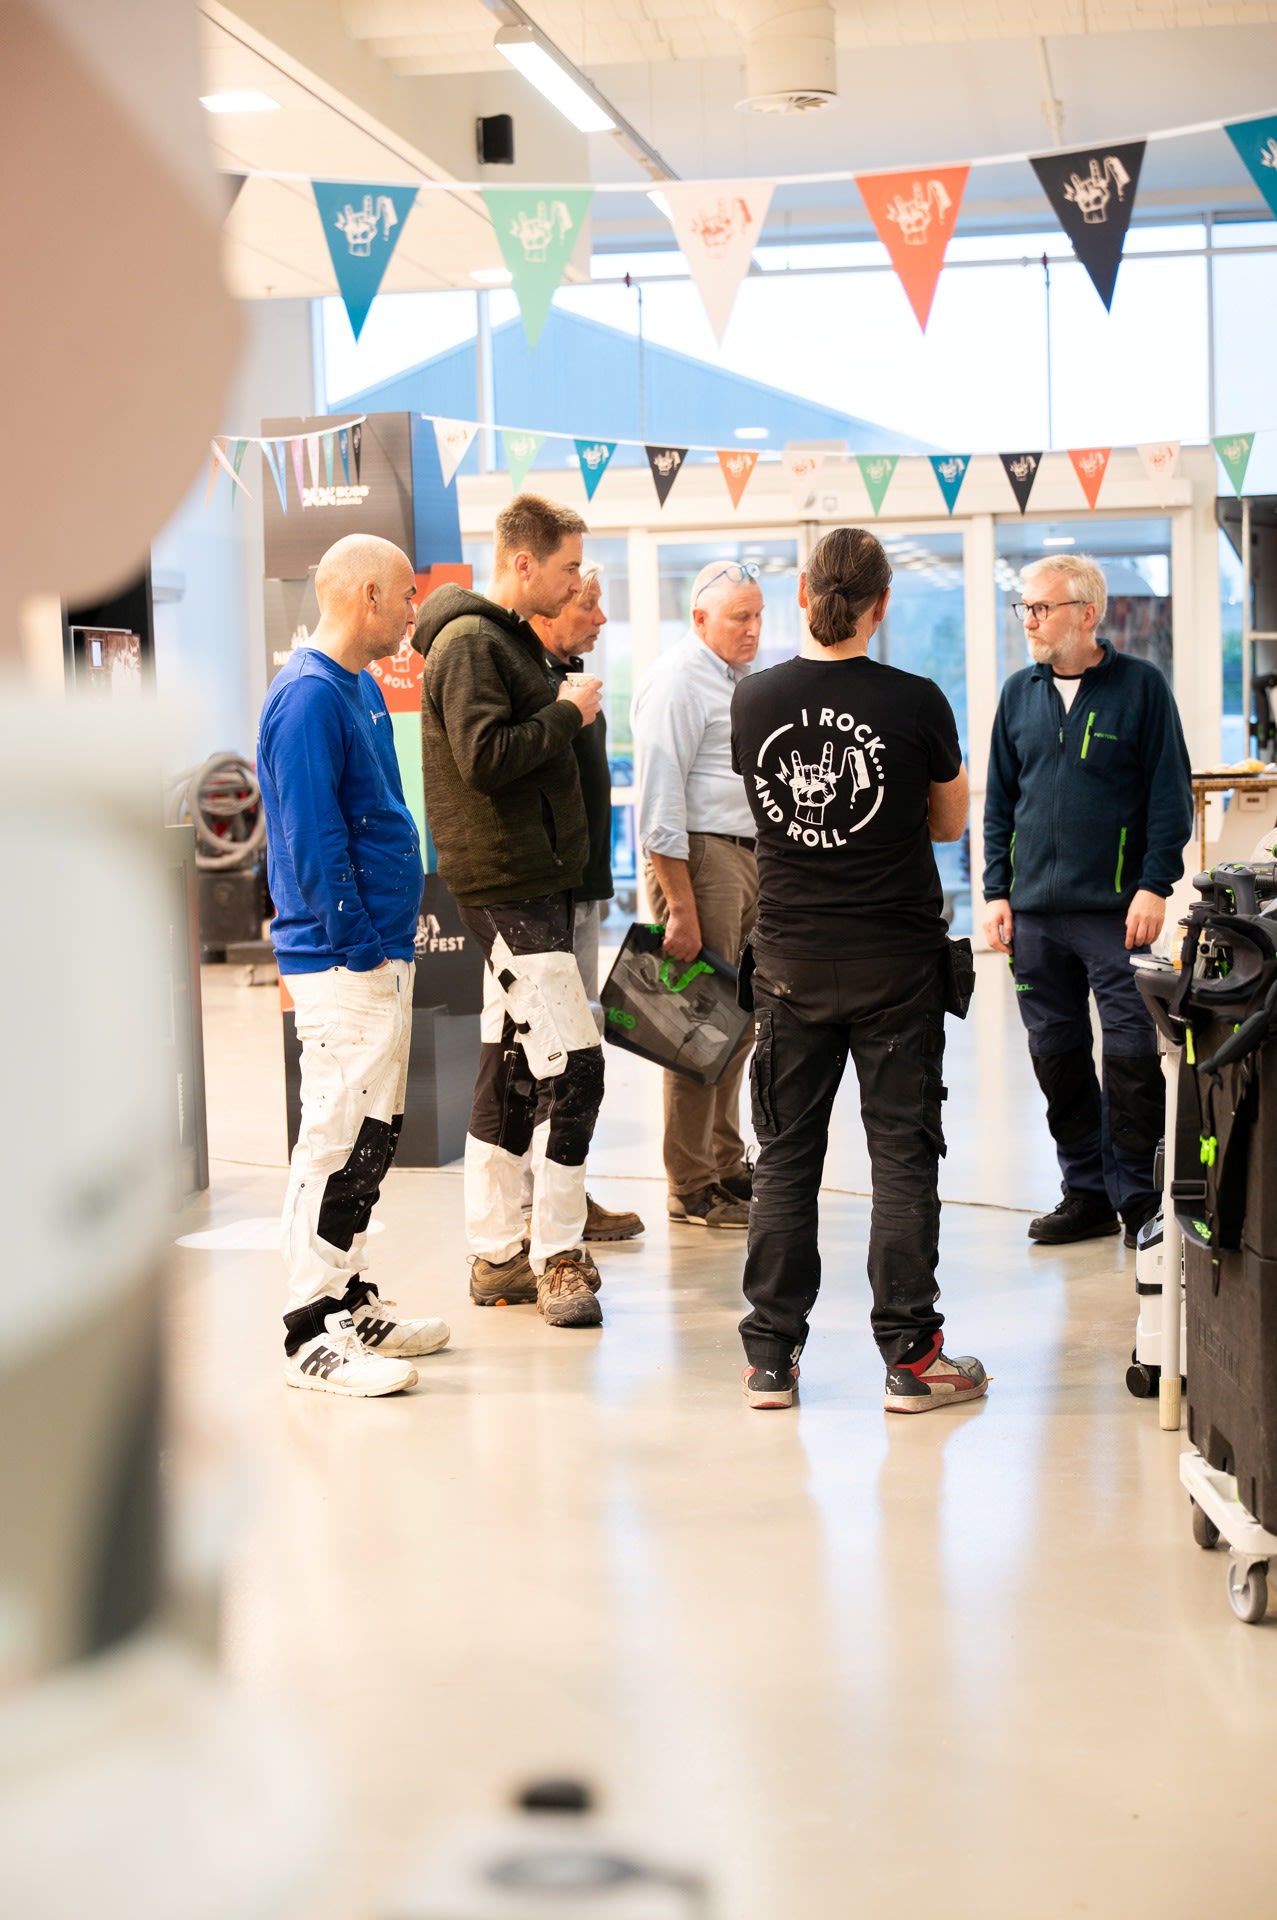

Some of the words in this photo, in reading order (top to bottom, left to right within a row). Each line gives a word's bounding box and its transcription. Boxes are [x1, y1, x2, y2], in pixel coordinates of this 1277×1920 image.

[368, 659, 383, 678] ND
[383, 673, 414, 689] ROLL
[801, 708, 809, 727] I
[754, 774, 784, 823] AND
[786, 821, 847, 849] ROLL
[430, 936, 466, 953] FEST
